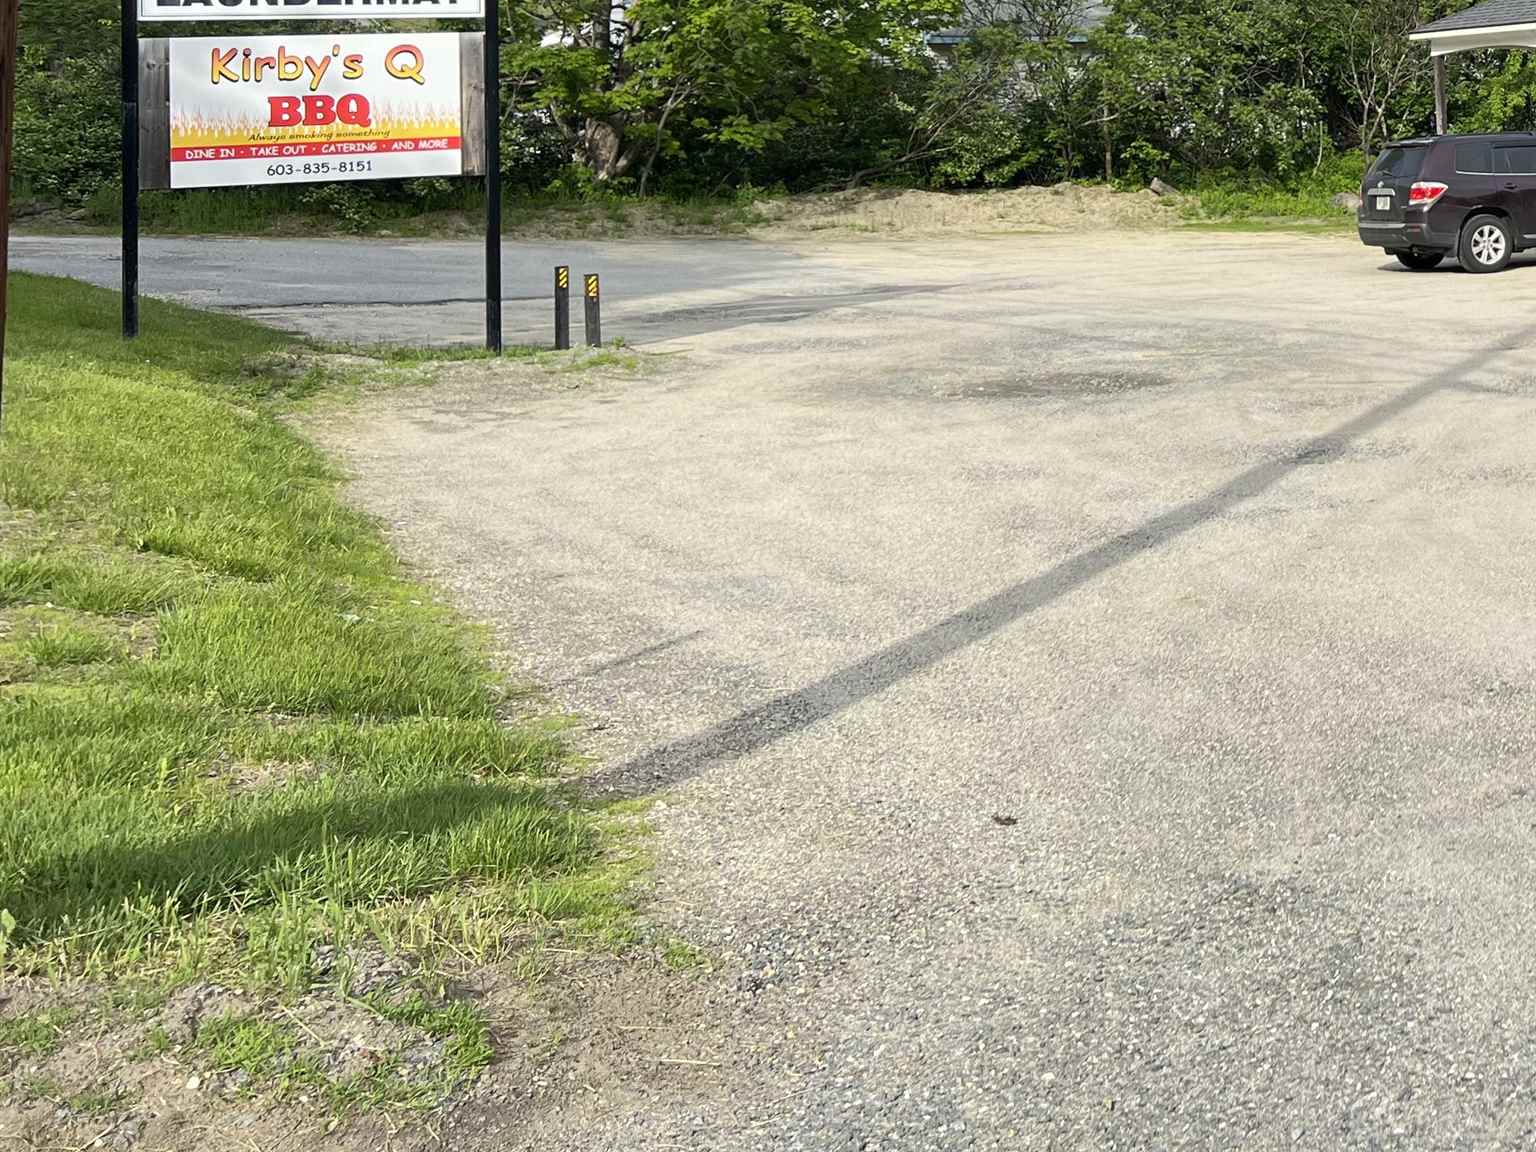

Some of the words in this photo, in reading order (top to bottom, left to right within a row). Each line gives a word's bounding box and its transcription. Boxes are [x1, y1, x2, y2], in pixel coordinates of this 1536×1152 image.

[211, 45, 364, 91] Kirby's
[384, 44, 426, 85] Q
[267, 94, 372, 128] BBQ
[288, 130, 333, 141] smoking
[335, 128, 391, 139] something
[185, 150, 214, 160] DINE
[220, 149, 235, 157] IN
[251, 146, 278, 157] TAKE
[282, 145, 307, 155] OUT
[321, 142, 377, 154] CATERING
[392, 141, 414, 150] AND
[418, 138, 449, 149] MORE
[266, 160, 373, 177] 603-835-8151
